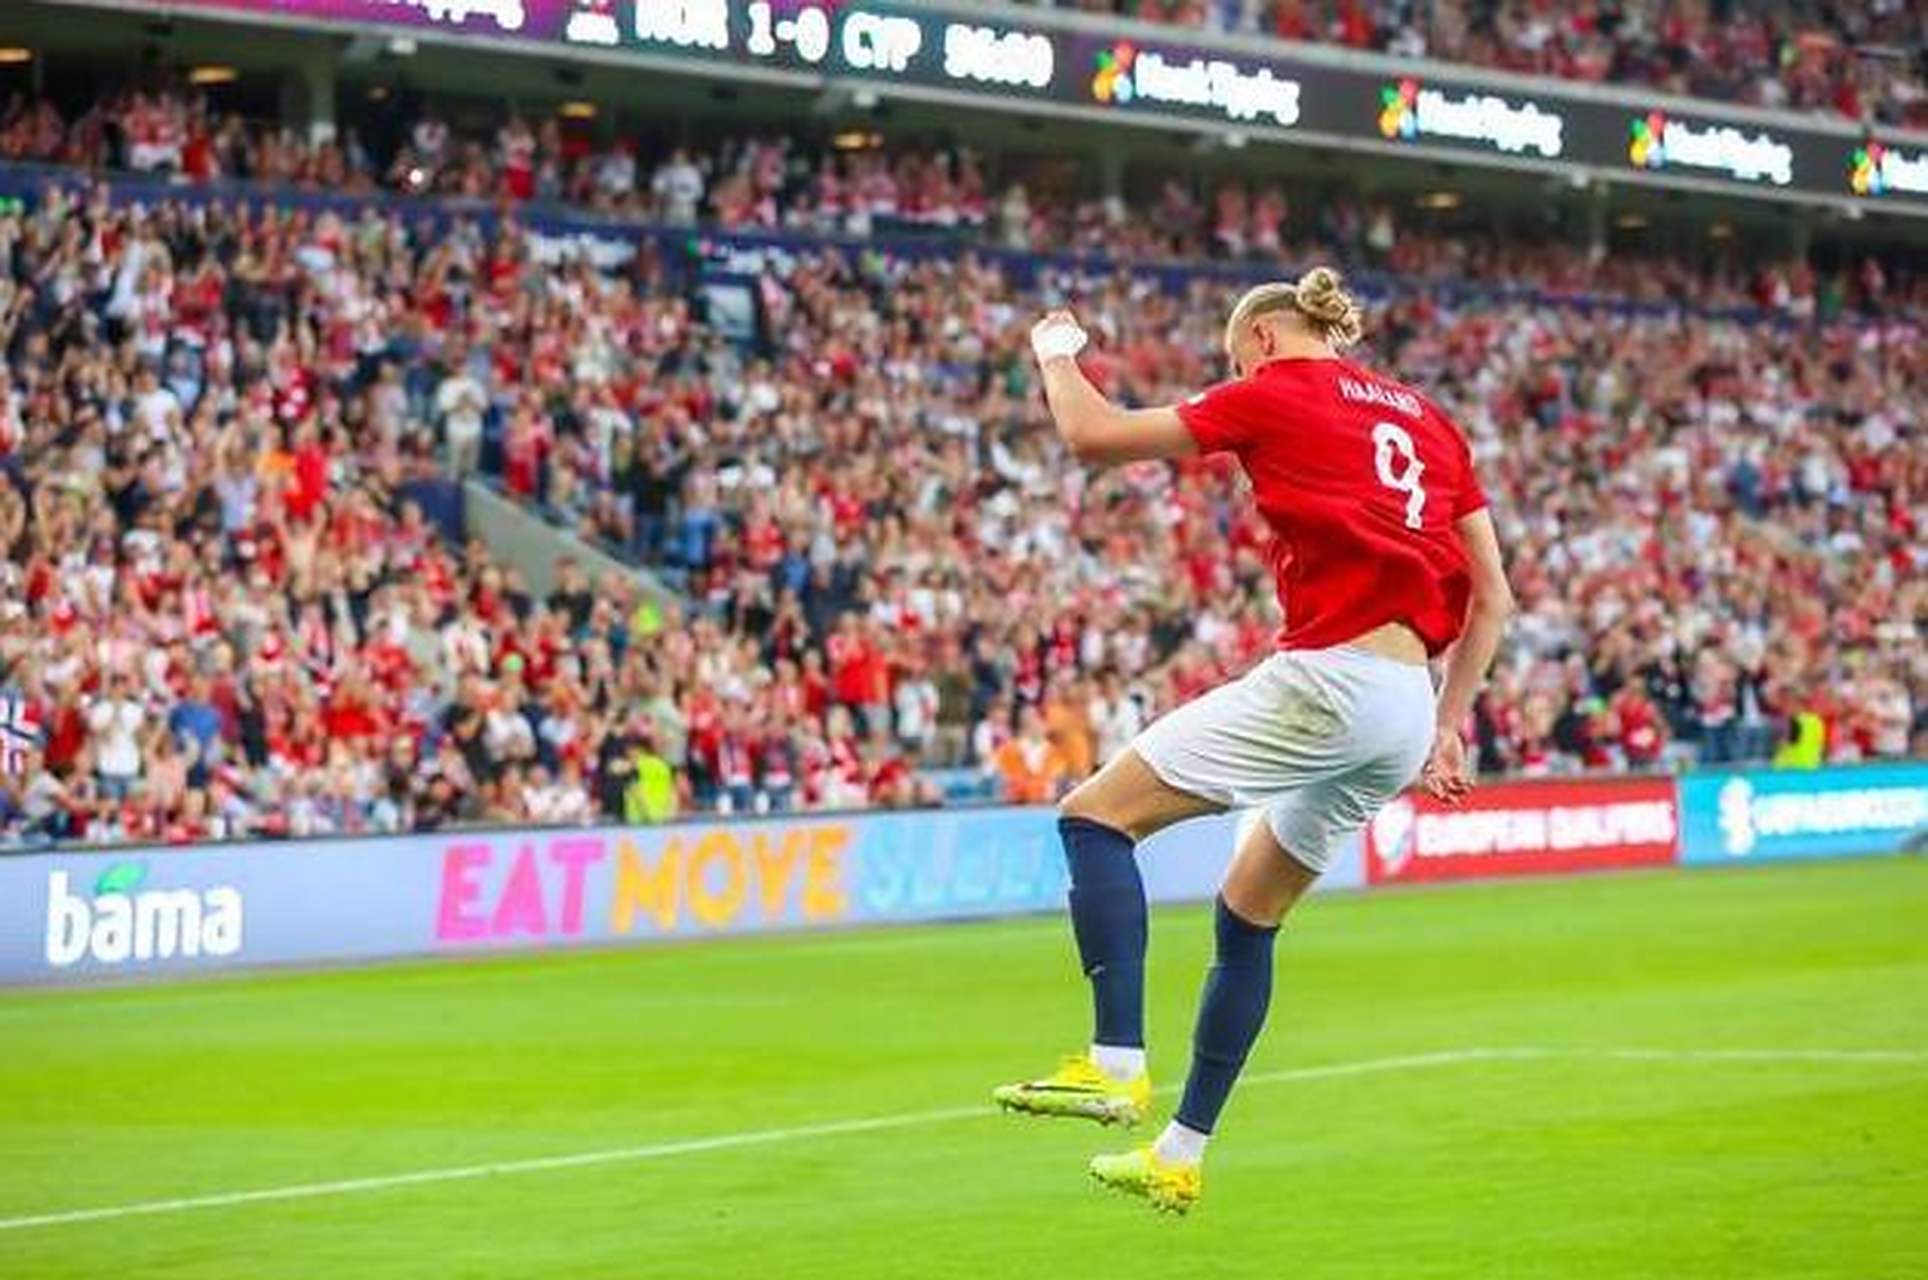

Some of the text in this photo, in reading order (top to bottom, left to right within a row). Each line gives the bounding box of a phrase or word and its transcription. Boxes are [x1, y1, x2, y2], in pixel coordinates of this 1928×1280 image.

[748, 3, 828, 61] 1-0
[843, 12, 921, 70] CYP
[1372, 421, 1426, 530] 9
[45, 869, 243, 965] bama
[435, 836, 603, 941] EAT
[609, 825, 855, 934] MOVE
